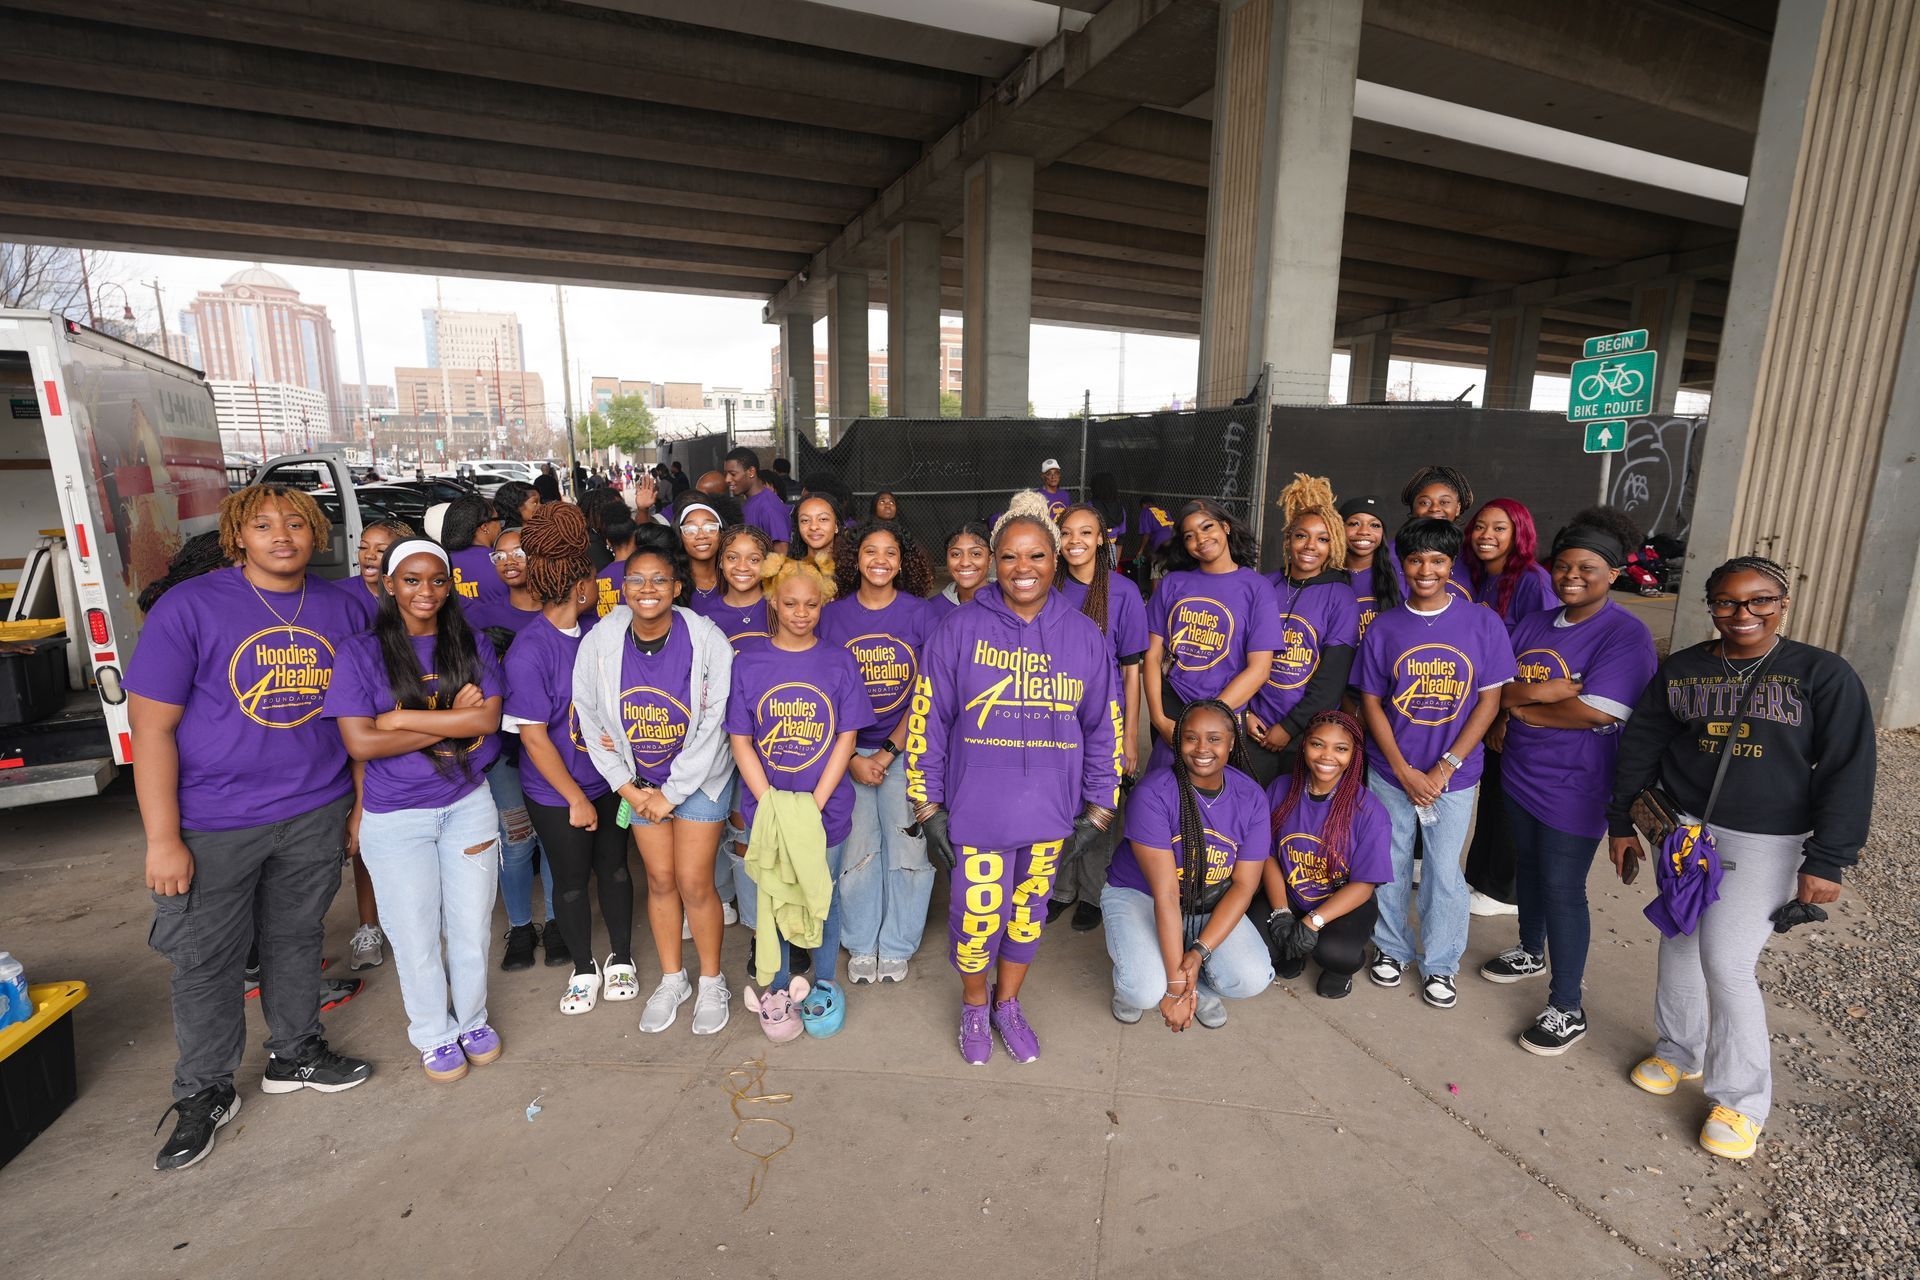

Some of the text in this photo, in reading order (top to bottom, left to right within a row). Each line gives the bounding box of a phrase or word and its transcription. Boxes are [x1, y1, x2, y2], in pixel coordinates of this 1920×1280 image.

[1596, 336, 1634, 353] BEGIN
[1574, 400, 1644, 418] BIKE ROUTE
[1178, 605, 1219, 629] Hoodies
[1187, 623, 1226, 651] Healing
[255, 644, 318, 666] Hoodies
[974, 639, 1052, 674] Hoodies
[275, 664, 333, 690] Healing
[865, 660, 909, 681] Healing
[1407, 657, 1456, 676] Hoodies
[1015, 671, 1084, 708] Healing
[1421, 675, 1465, 699] Healing
[1669, 677, 1698, 687] PRAIRIE
[1701, 676, 1723, 684] VIEW
[623, 701, 669, 722] Hoodies
[769, 697, 817, 717] Hoodies
[637, 719, 686, 739] Healing
[783, 716, 825, 742] Healing
